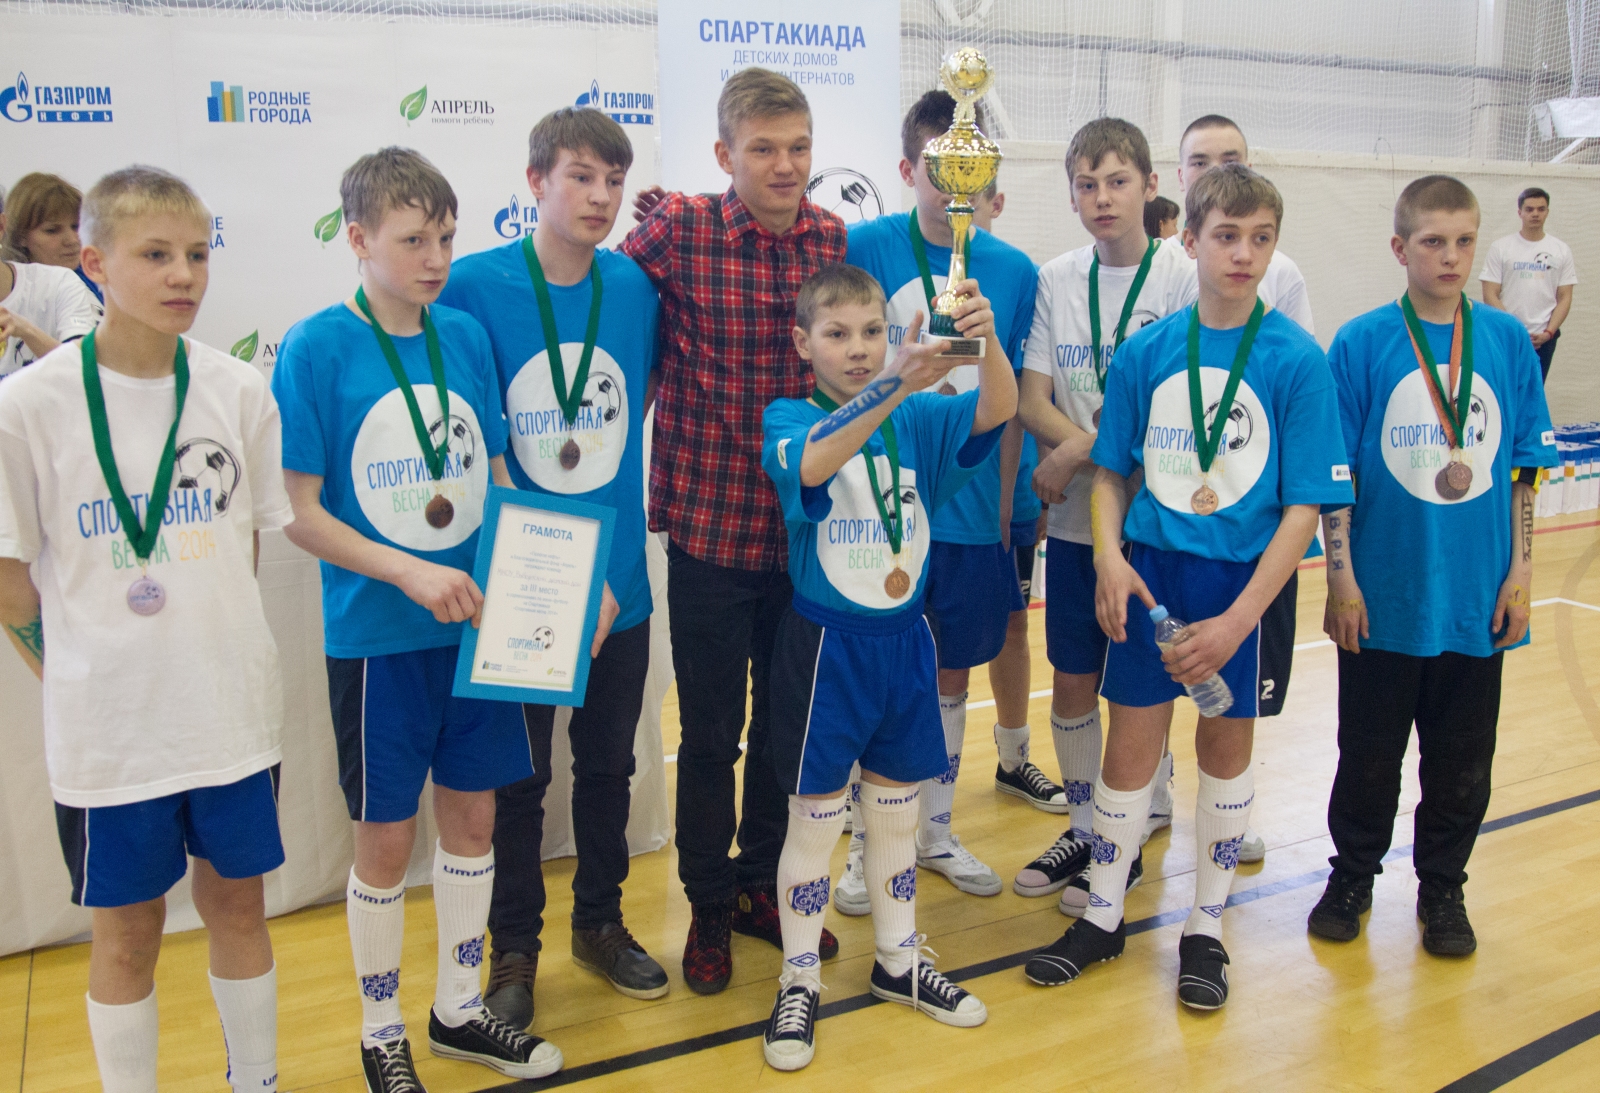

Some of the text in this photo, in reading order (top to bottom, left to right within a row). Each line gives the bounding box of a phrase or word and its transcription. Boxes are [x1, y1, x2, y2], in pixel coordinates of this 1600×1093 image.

[699, 18, 867, 51] СПАРТАКИАДА
[733, 50, 838, 67] ДЕТСКИХ ДОМОВ
[720, 69, 729, 82] И
[34, 86, 112, 105] ГАЗПРОМ
[248, 91, 311, 106] РОДНЫЕ
[38, 111, 112, 122] НЕФТЬ
[249, 108, 312, 124] ГОРОДА
[431, 100, 495, 114] АПРЕЛЬ
[1158, 454, 1193, 476] ВЕСНА
[1410, 449, 1442, 469] ВЕСНА
[522, 523, 574, 542] ГРАМОТА
[178, 529, 217, 561] 2014
[848, 548, 886, 569] ВЕСНА
[539, 586, 559, 596] место
[1260, 679, 1275, 700] 2
